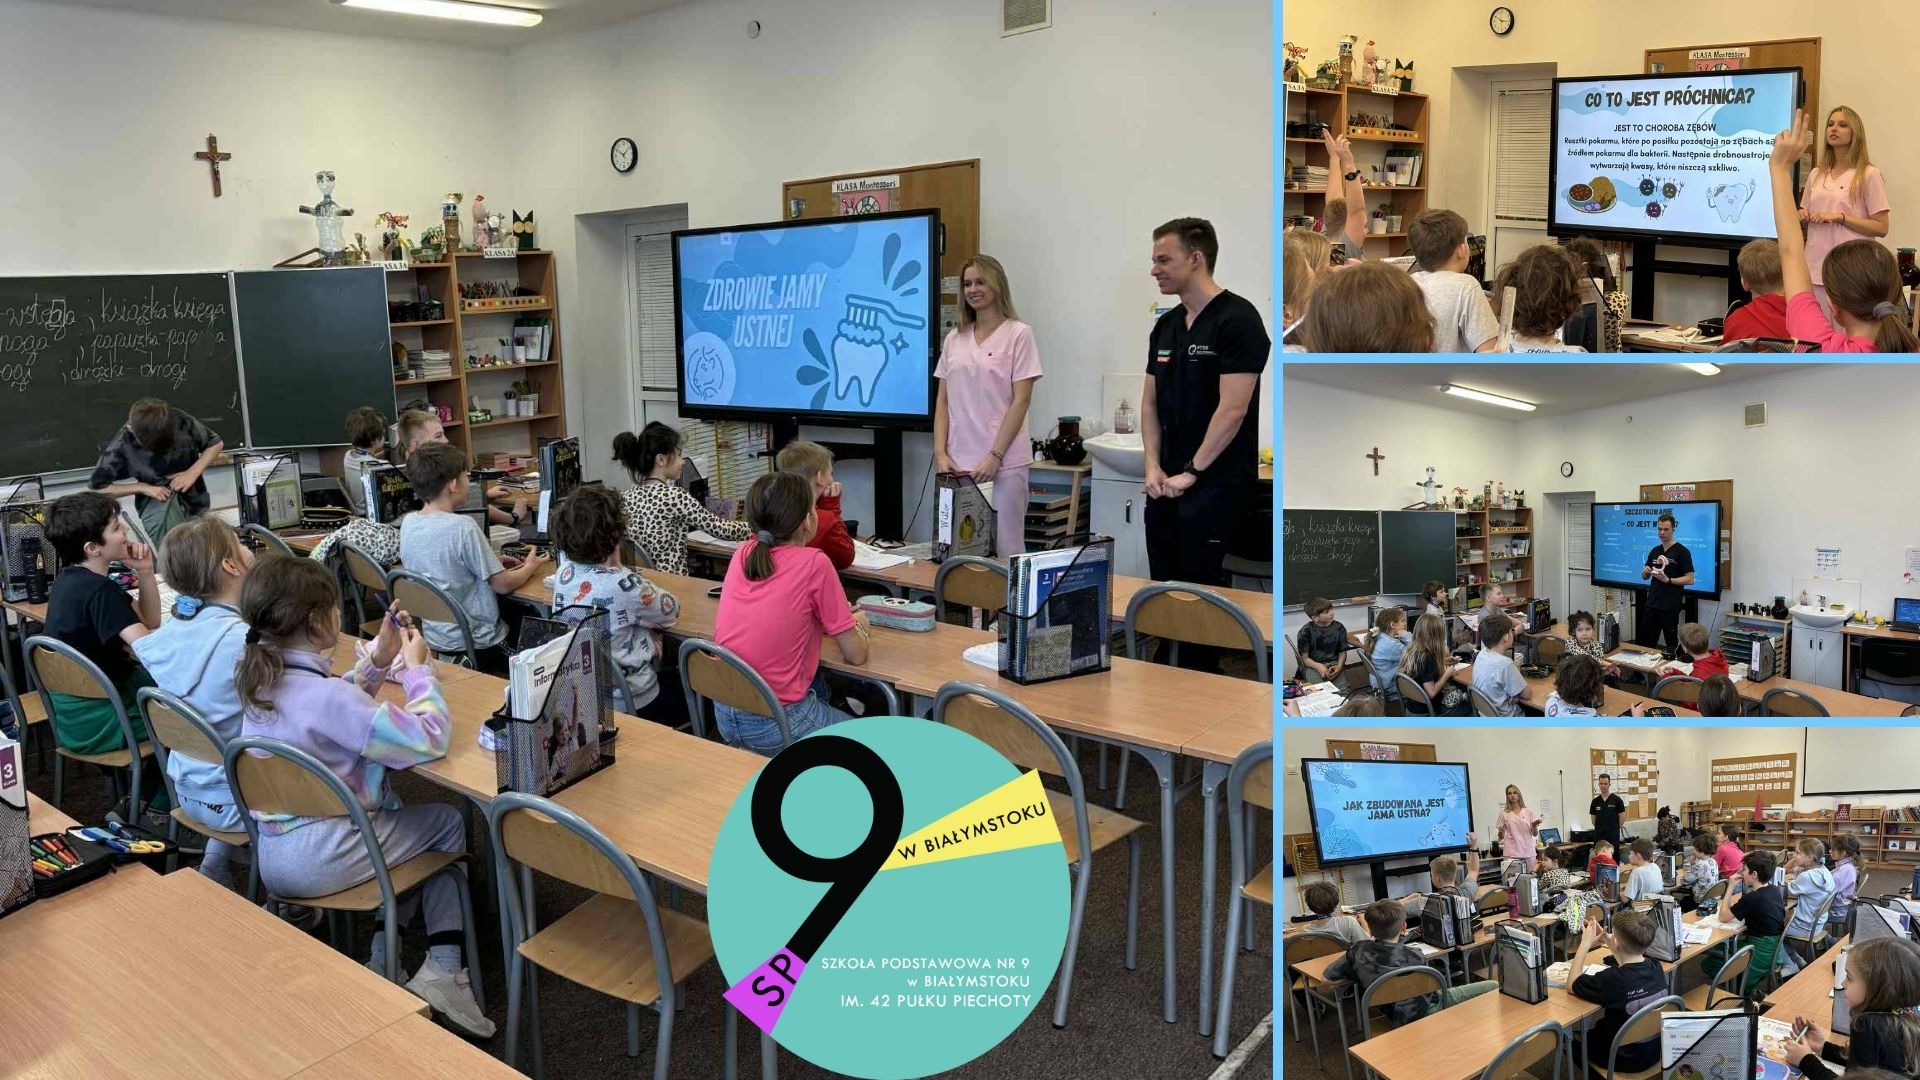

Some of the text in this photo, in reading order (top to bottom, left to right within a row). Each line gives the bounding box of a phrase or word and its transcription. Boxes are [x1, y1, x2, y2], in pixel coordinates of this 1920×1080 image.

[1585, 85, 1755, 107] CO TO JEST PRÓCHNICA?
[1614, 121, 1717, 133] JEST TO CHOROBA ZĘBÓW
[1588, 137, 1620, 146] pokarmu,
[1652, 137, 1679, 146] posiłku
[1680, 138, 1719, 147] pozostają
[1733, 137, 1764, 147] zębach
[1765, 138, 1776, 147] są
[1567, 148, 1770, 160] źródłem pokarmu dla bakterii. Następnie drobnoustroje
[1590, 162, 1630, 171] wytwarzają
[1630, 162, 1655, 171] kwasy,
[1677, 163, 1706, 173] niszczą
[1708, 163, 1740, 172] szkliwo.
[836, 180, 897, 192] KLASA Montessori
[703, 273, 827, 311] ZDROWIE JAMY
[733, 313, 795, 348] USTNEJ
[1626, 520, 1635, 528] CO
[1636, 520, 1651, 528] JEST
[3, 763, 14, 779] 3
[1343, 798, 1446, 811] JAK ZBUDOWANA JEST
[1367, 808, 1431, 820] JAMA USTNA?
